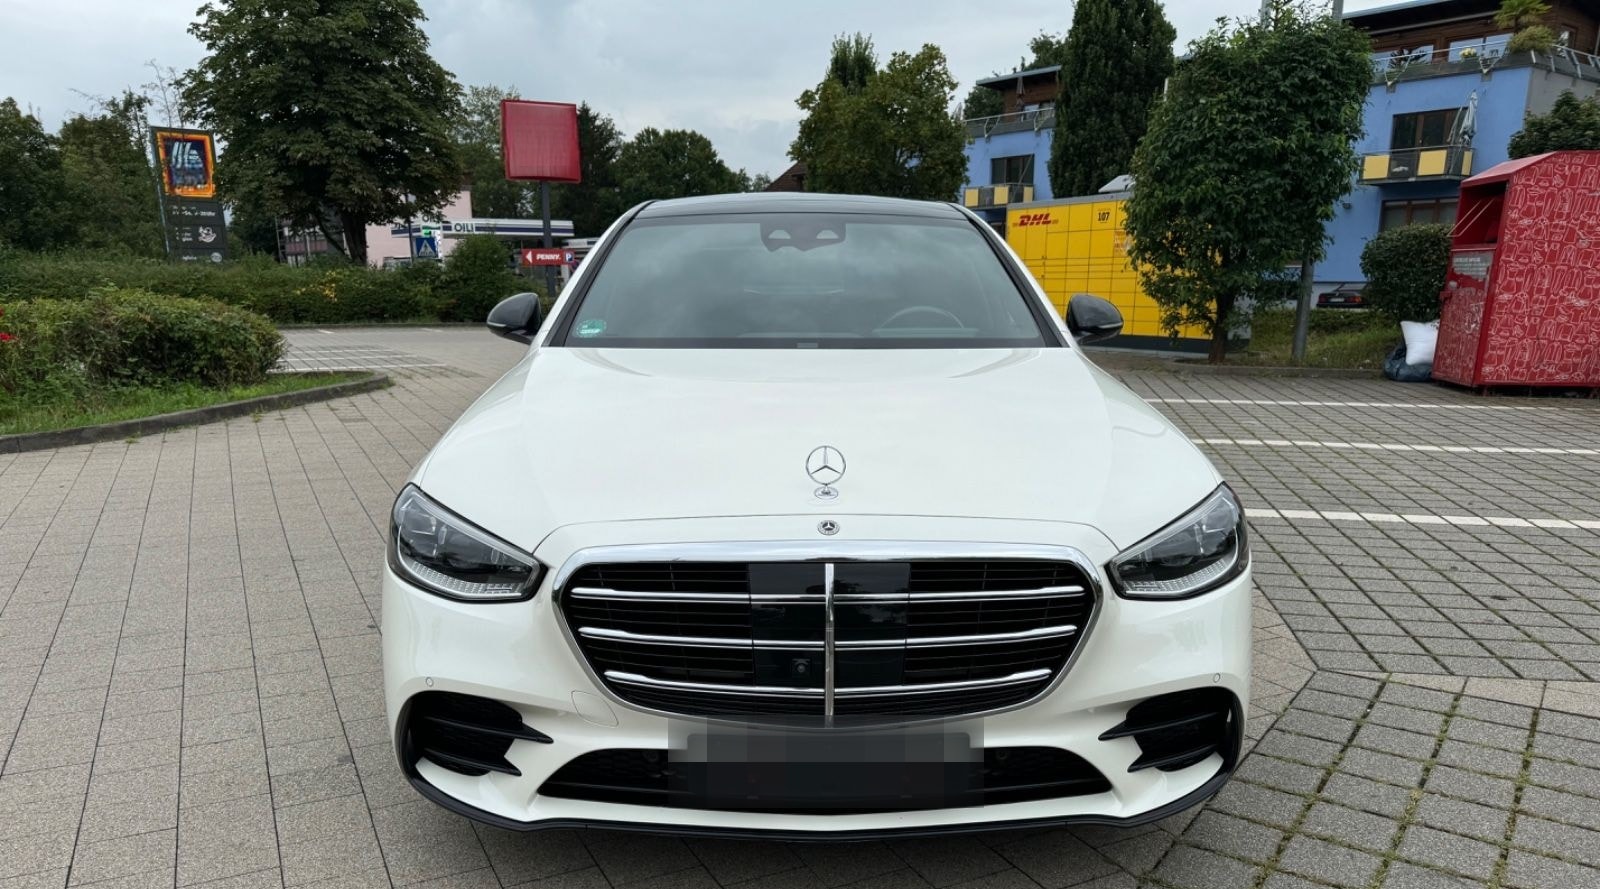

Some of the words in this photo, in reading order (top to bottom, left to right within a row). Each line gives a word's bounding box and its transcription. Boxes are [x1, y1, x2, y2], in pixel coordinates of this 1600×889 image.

[1019, 213, 1052, 226] DHL
[1098, 212, 1110, 221] 107
[565, 252, 573, 262] P
